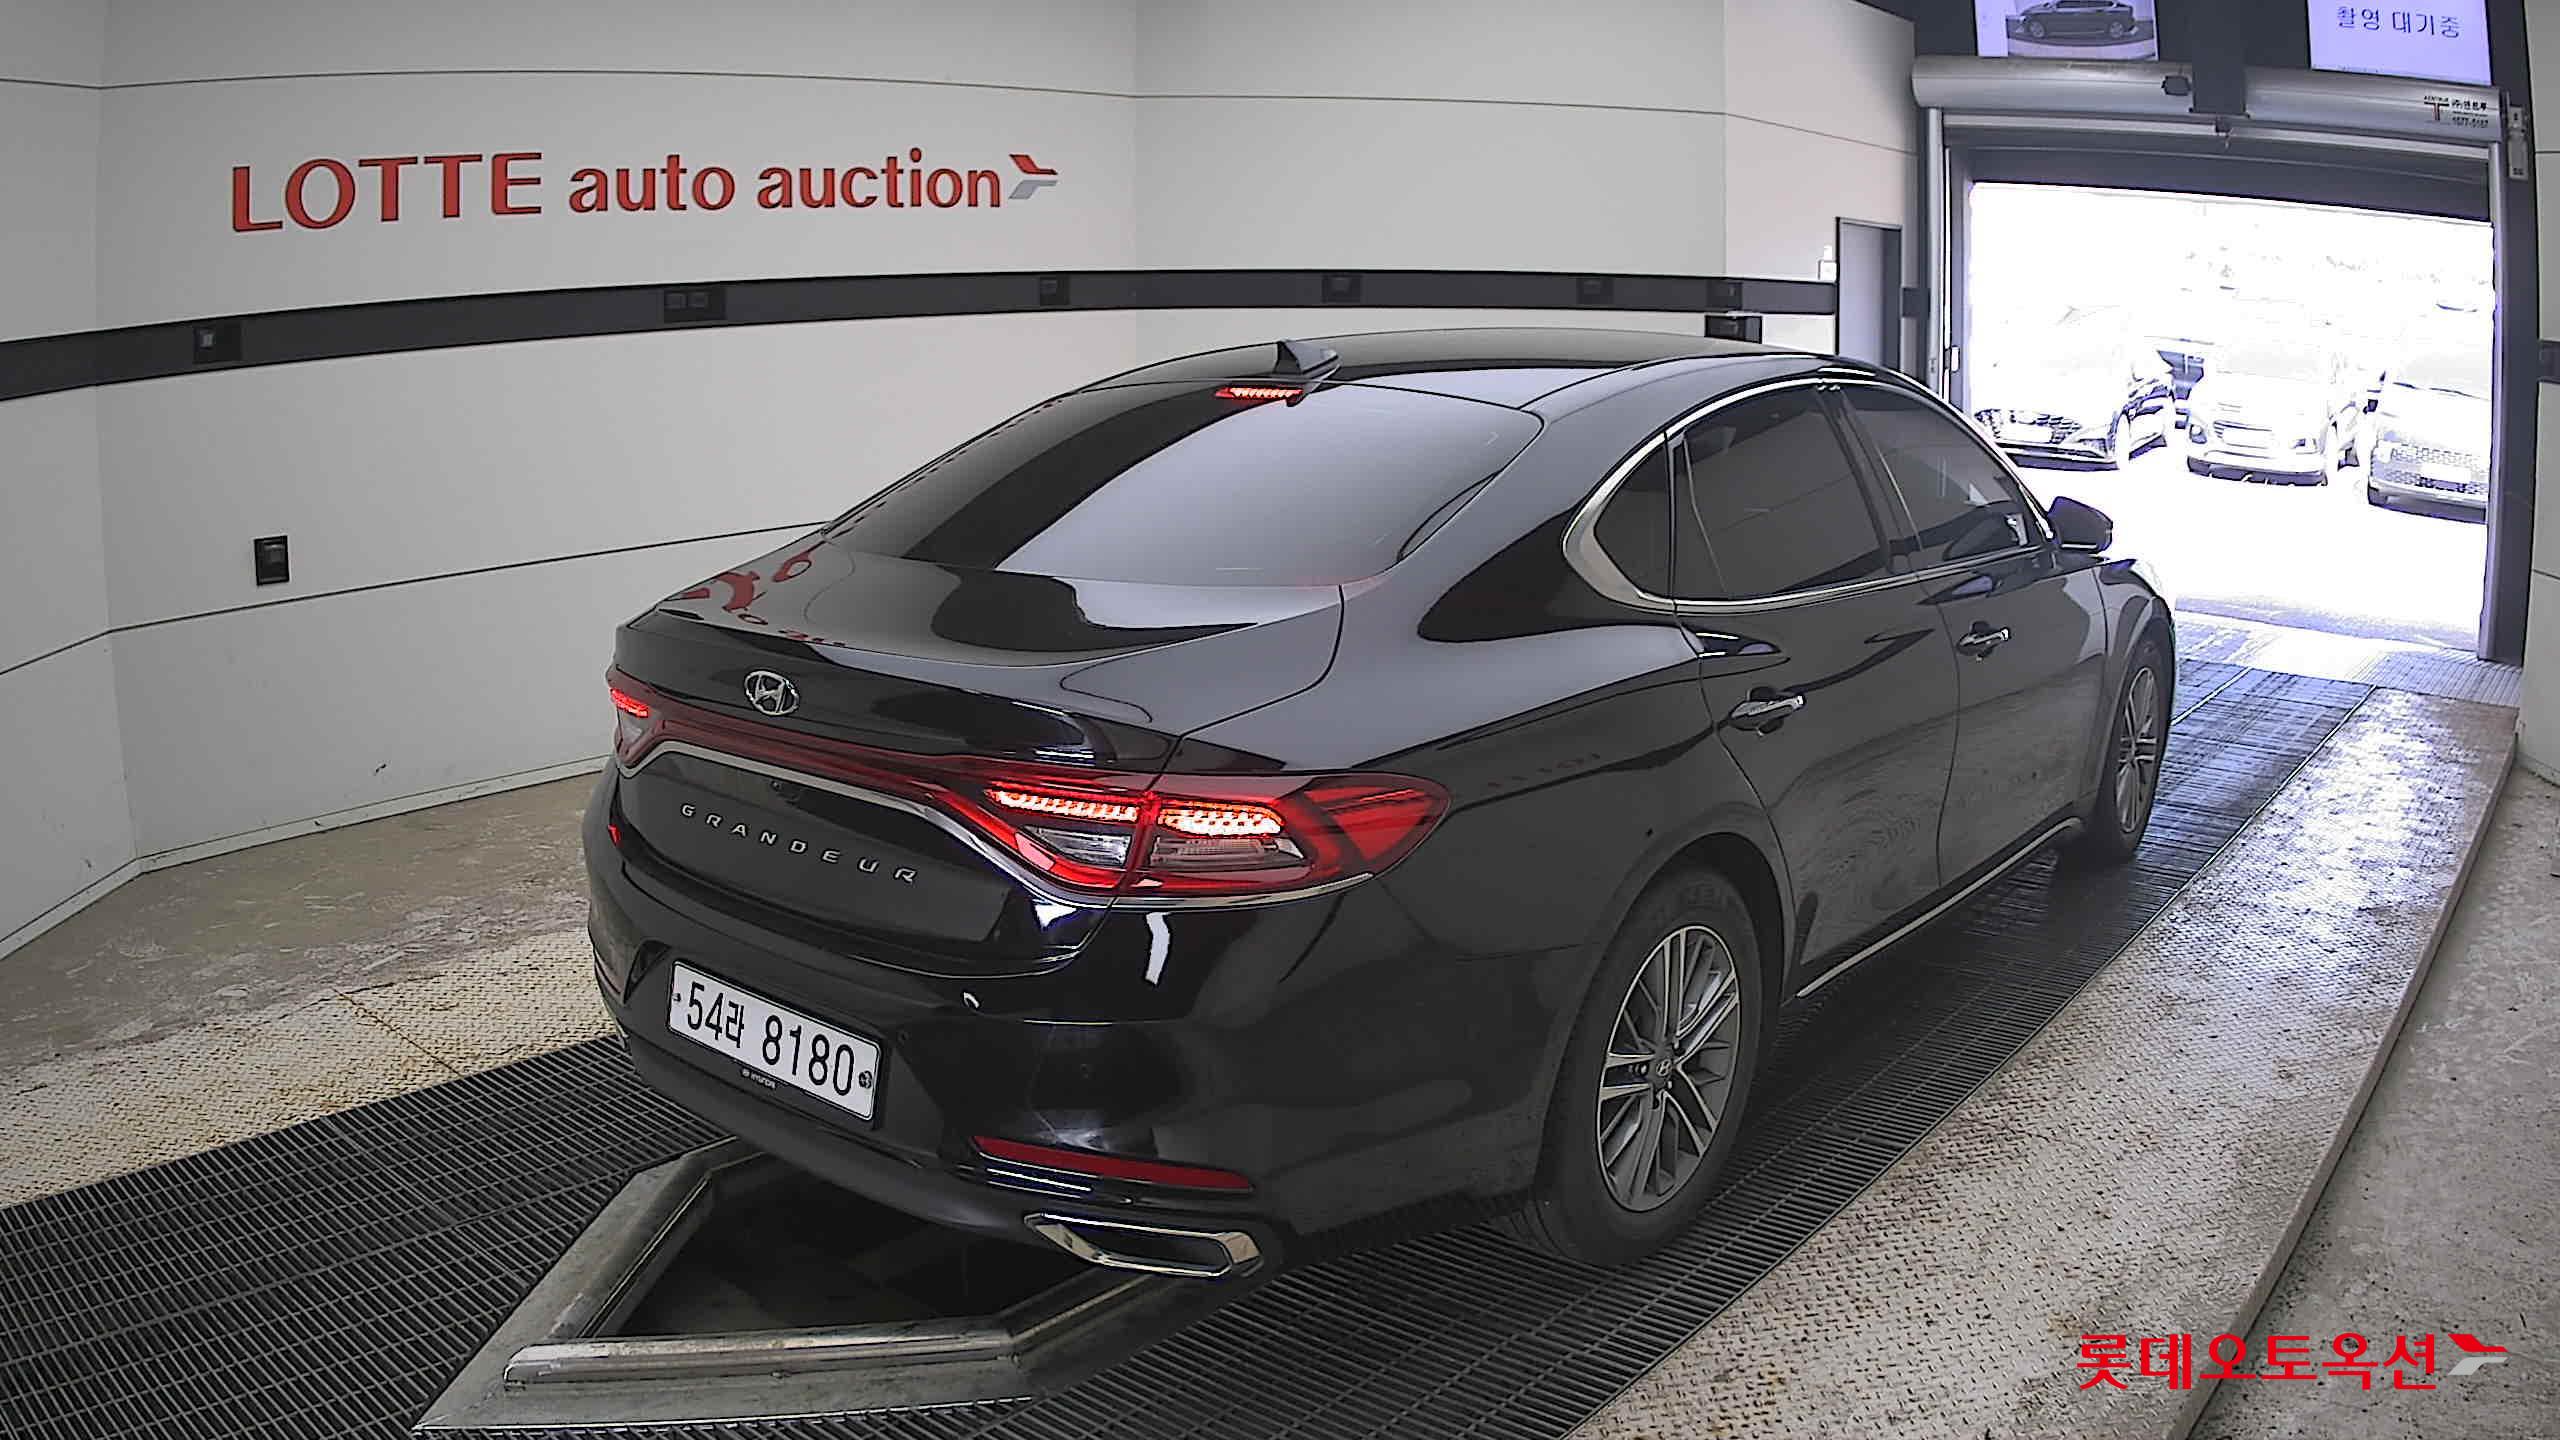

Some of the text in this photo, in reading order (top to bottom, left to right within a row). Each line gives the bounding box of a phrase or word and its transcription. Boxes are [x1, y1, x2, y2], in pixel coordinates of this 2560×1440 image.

[2336, 6, 2460, 39] 촬영 대기중
[231, 147, 1002, 233] LOTTE auto auction
[680, 803, 918, 883] GRANDEUR
[686, 981, 855, 1096] 54라 8180
